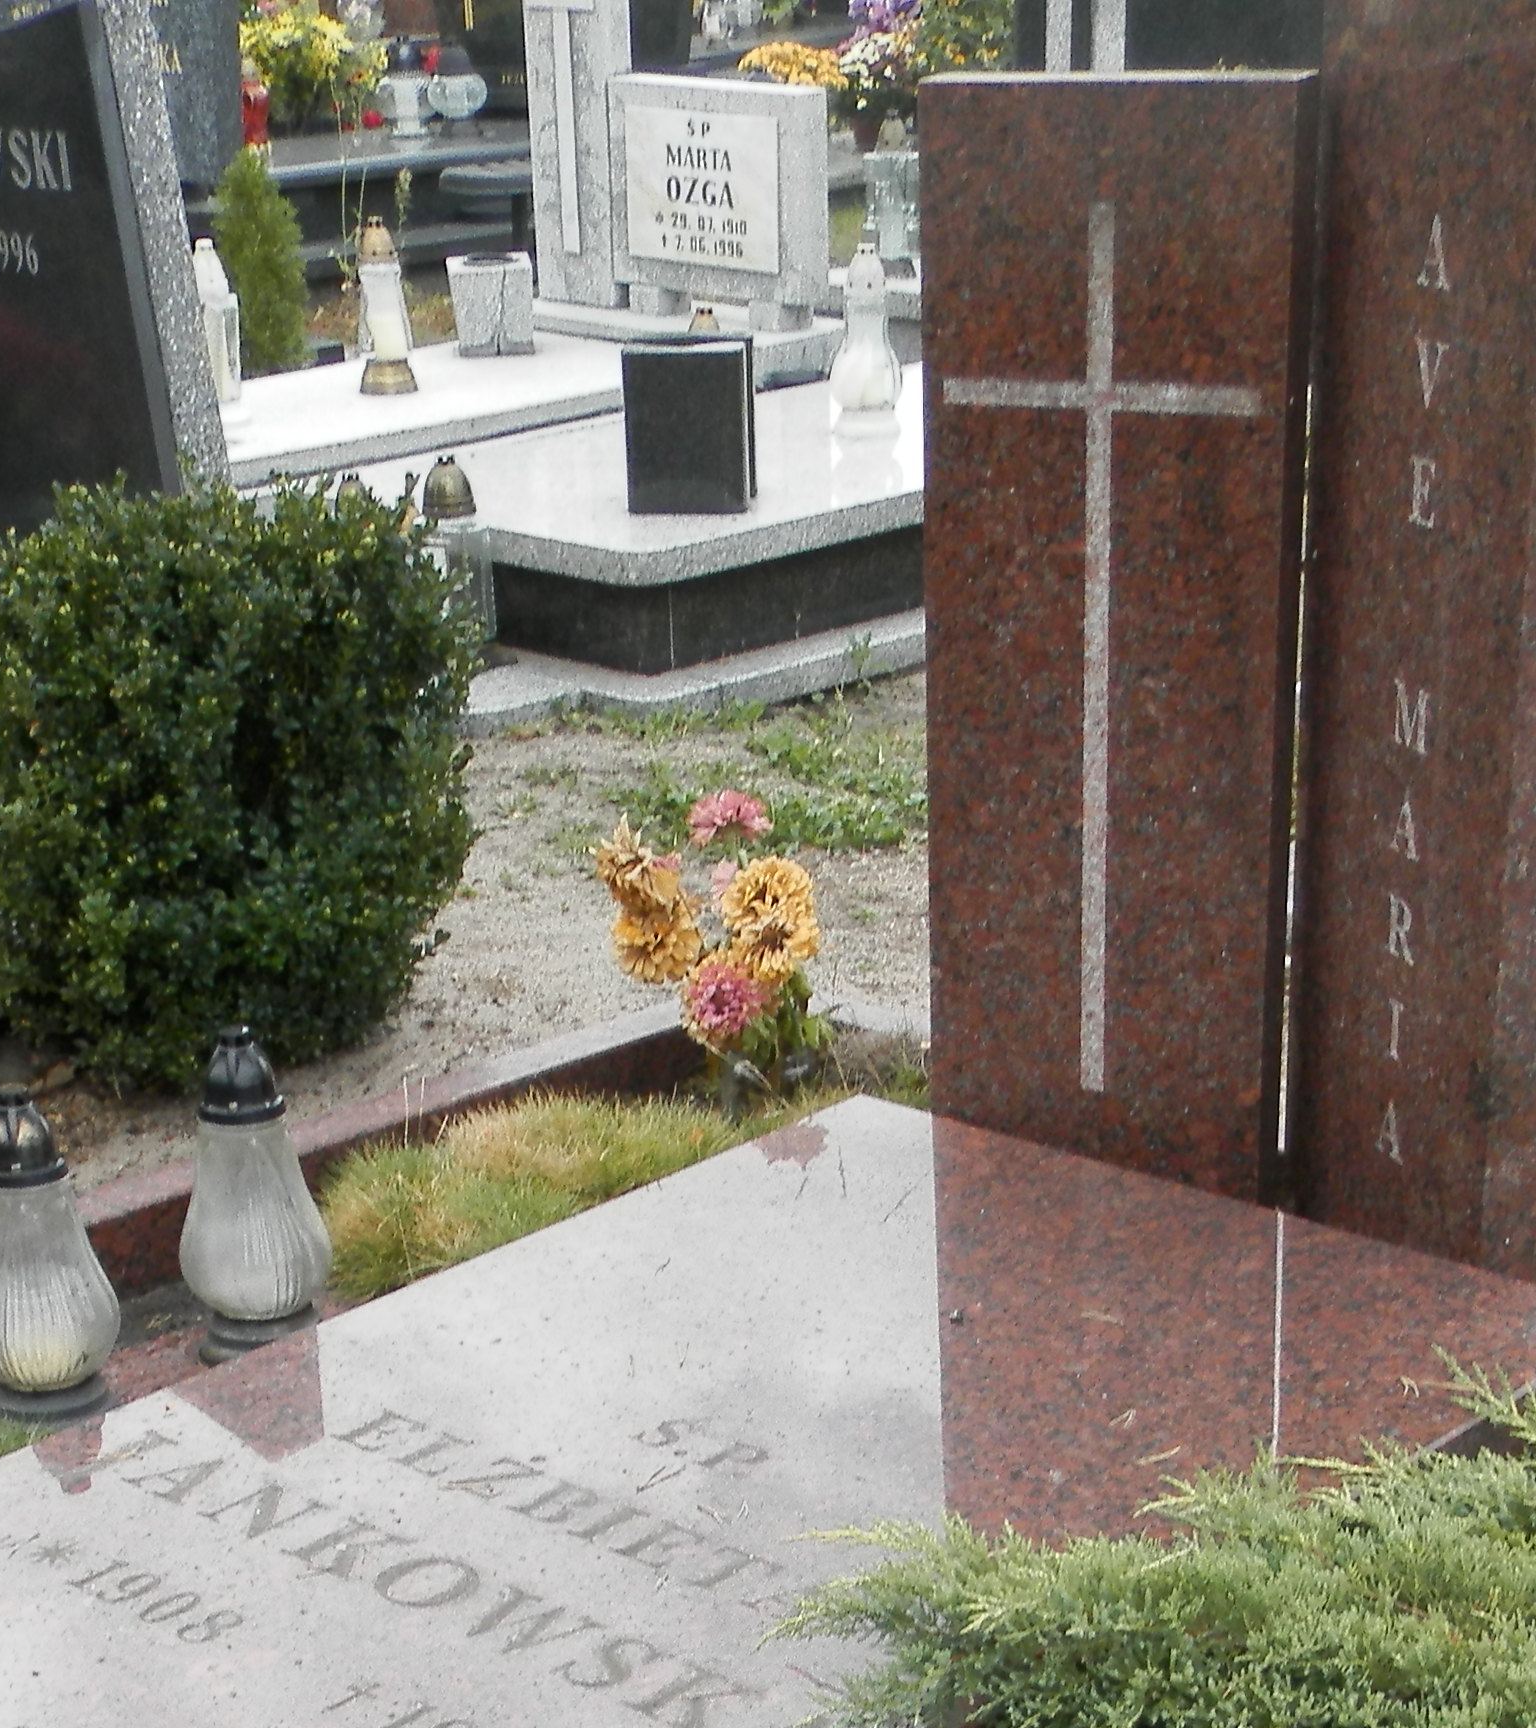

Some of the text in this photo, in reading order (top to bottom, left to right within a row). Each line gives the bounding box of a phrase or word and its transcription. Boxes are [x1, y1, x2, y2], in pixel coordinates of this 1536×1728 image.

[665, 143, 733, 173] MARTA
[666, 175, 734, 210] OZGA
[329, 1408, 799, 1613] ELŻBIET
[65, 1556, 244, 1644] 1908
